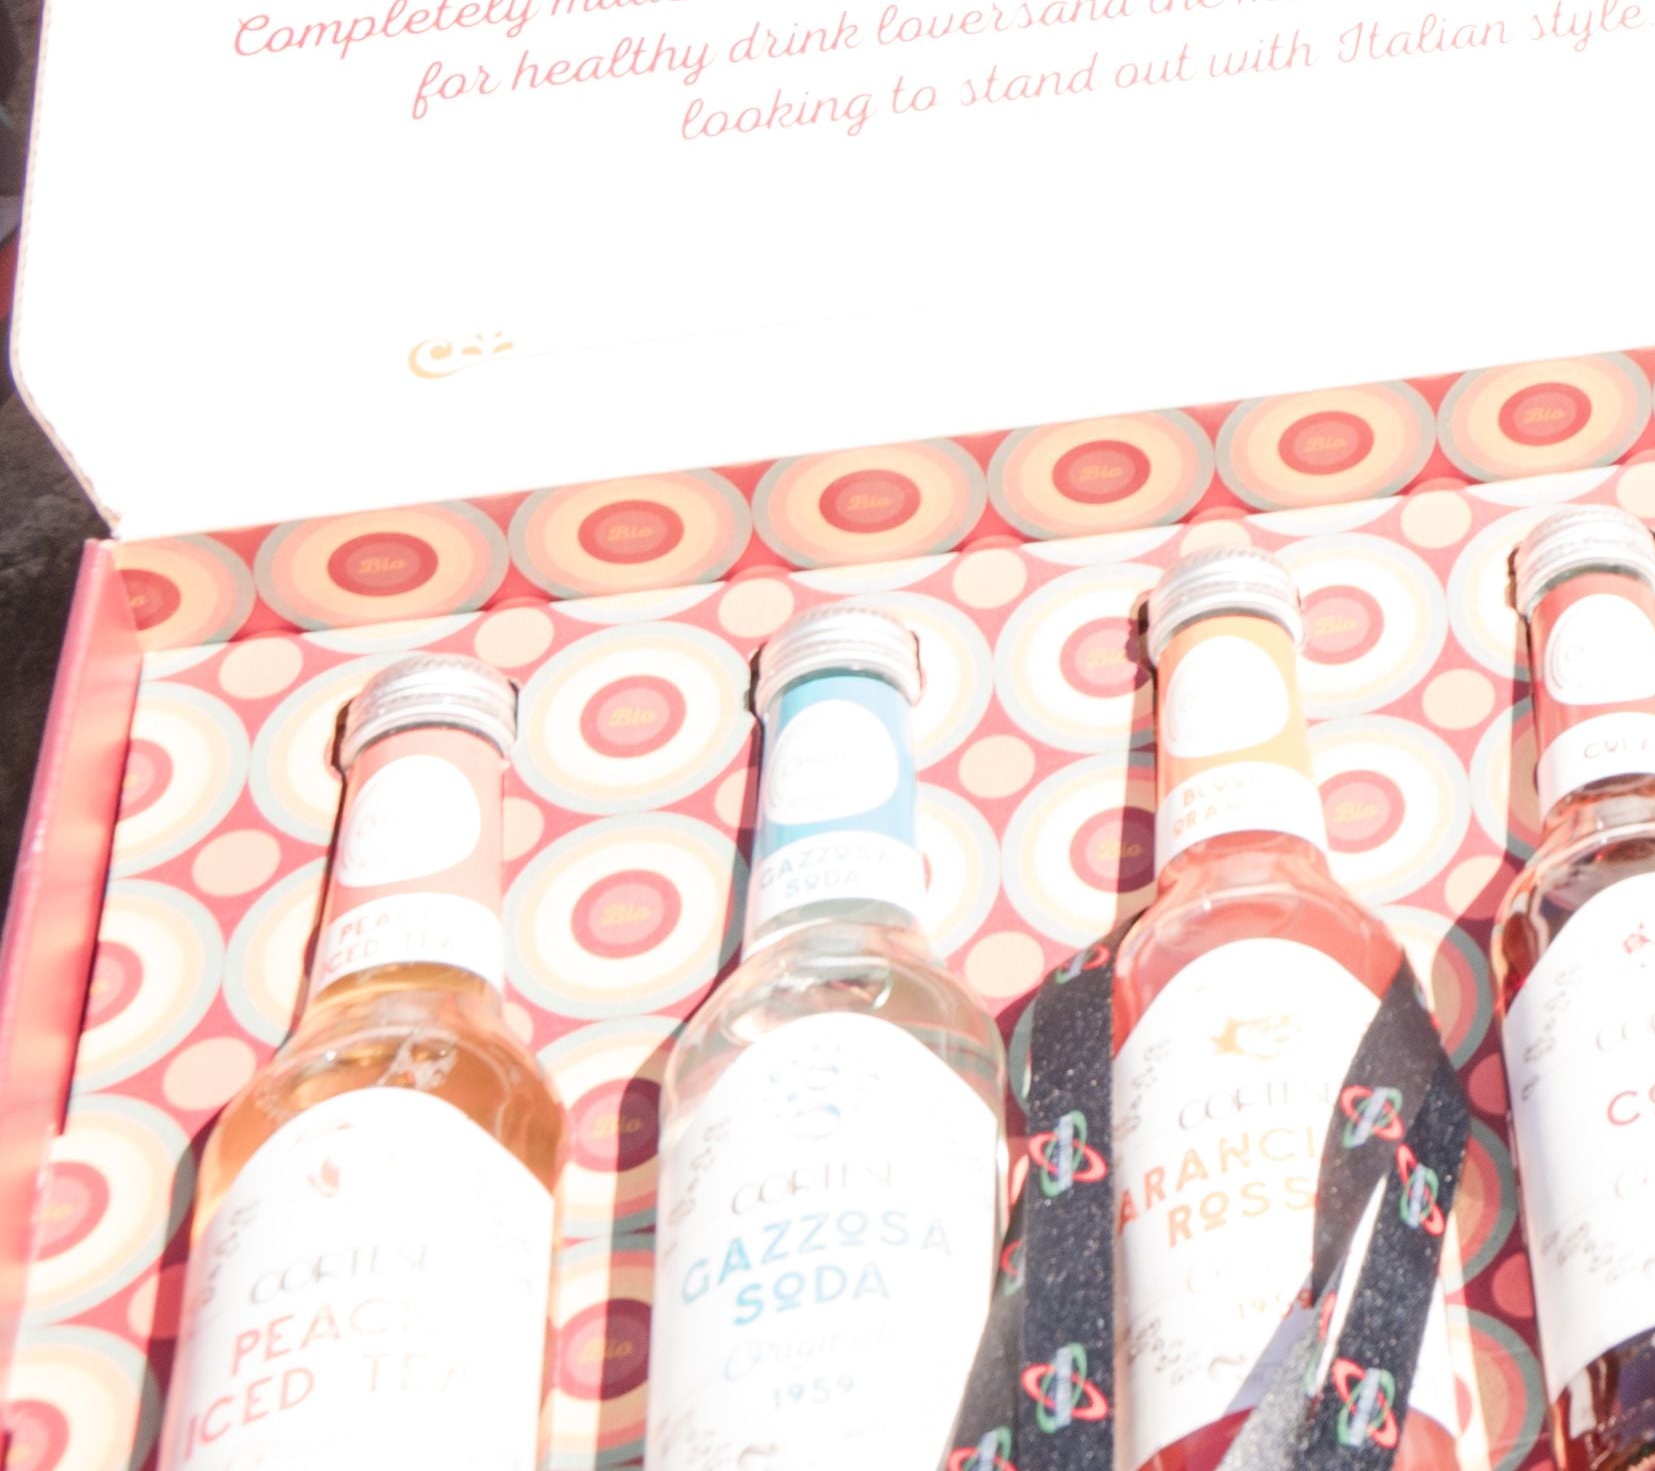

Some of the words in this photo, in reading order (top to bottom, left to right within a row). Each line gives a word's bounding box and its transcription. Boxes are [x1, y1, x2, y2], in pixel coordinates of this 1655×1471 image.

[410, 58, 502, 122] for
[510, 30, 716, 92] healthy
[727, 9, 862, 64] drink
[680, 87, 874, 141] looking
[891, 74, 939, 114] to
[959, 49, 1099, 107] stand
[1113, 41, 1194, 89] out
[1208, 27, 1314, 78] with
[1337, 12, 1508, 64] Italian
[1118, 1124, 1316, 1225] ARANCI
[1165, 1175, 1318, 1250] ROSS
[679, 1208, 954, 1306] GAZZOSA
[731, 1262, 892, 1327] SODA
[229, 1296, 405, 1379] PEAC
